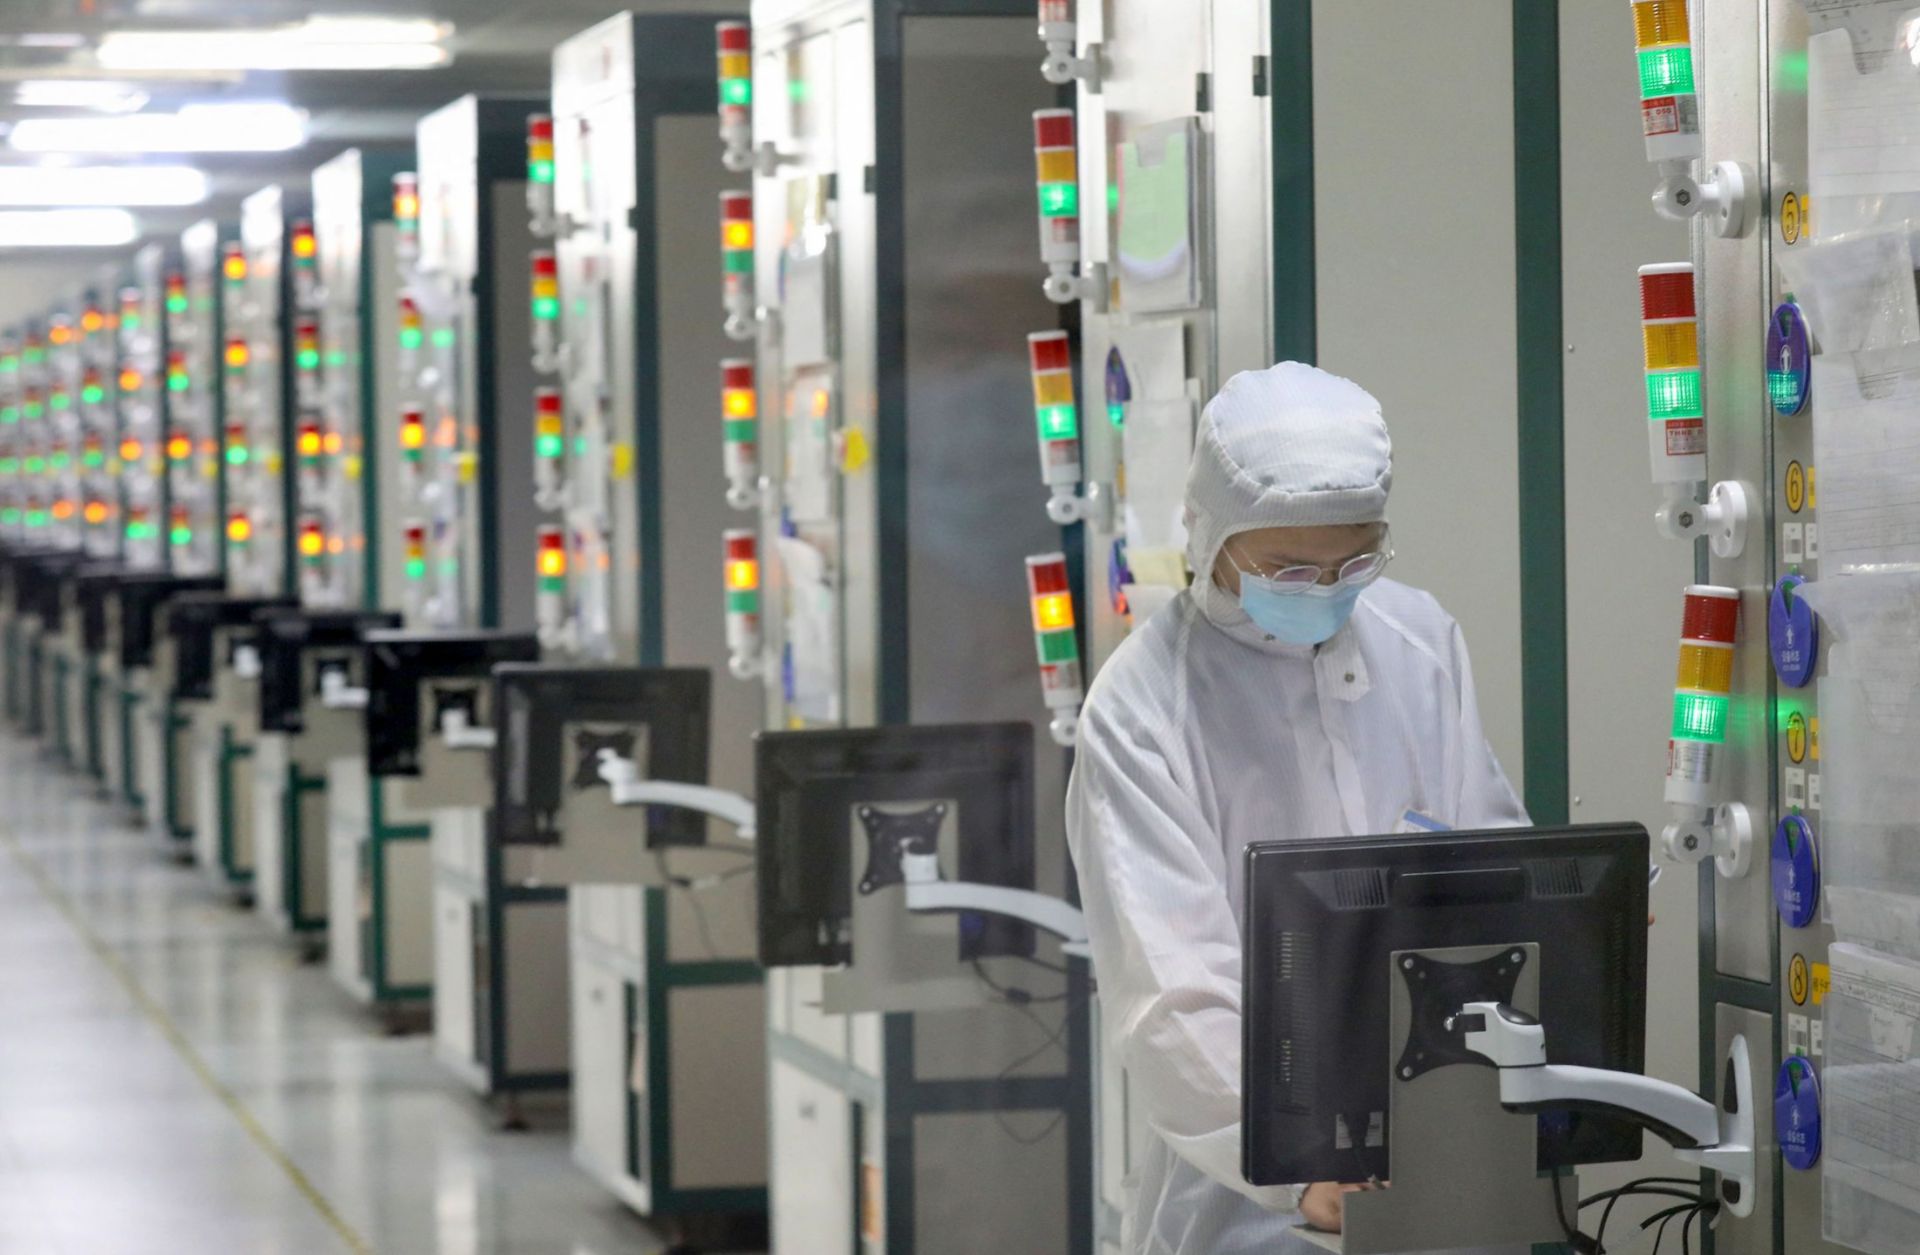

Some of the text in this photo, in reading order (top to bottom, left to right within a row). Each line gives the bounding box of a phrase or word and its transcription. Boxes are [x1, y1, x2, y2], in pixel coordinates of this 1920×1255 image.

[1791, 467, 1799, 503] 6
[1792, 718, 1800, 753] 7
[1794, 960, 1803, 995] 8
